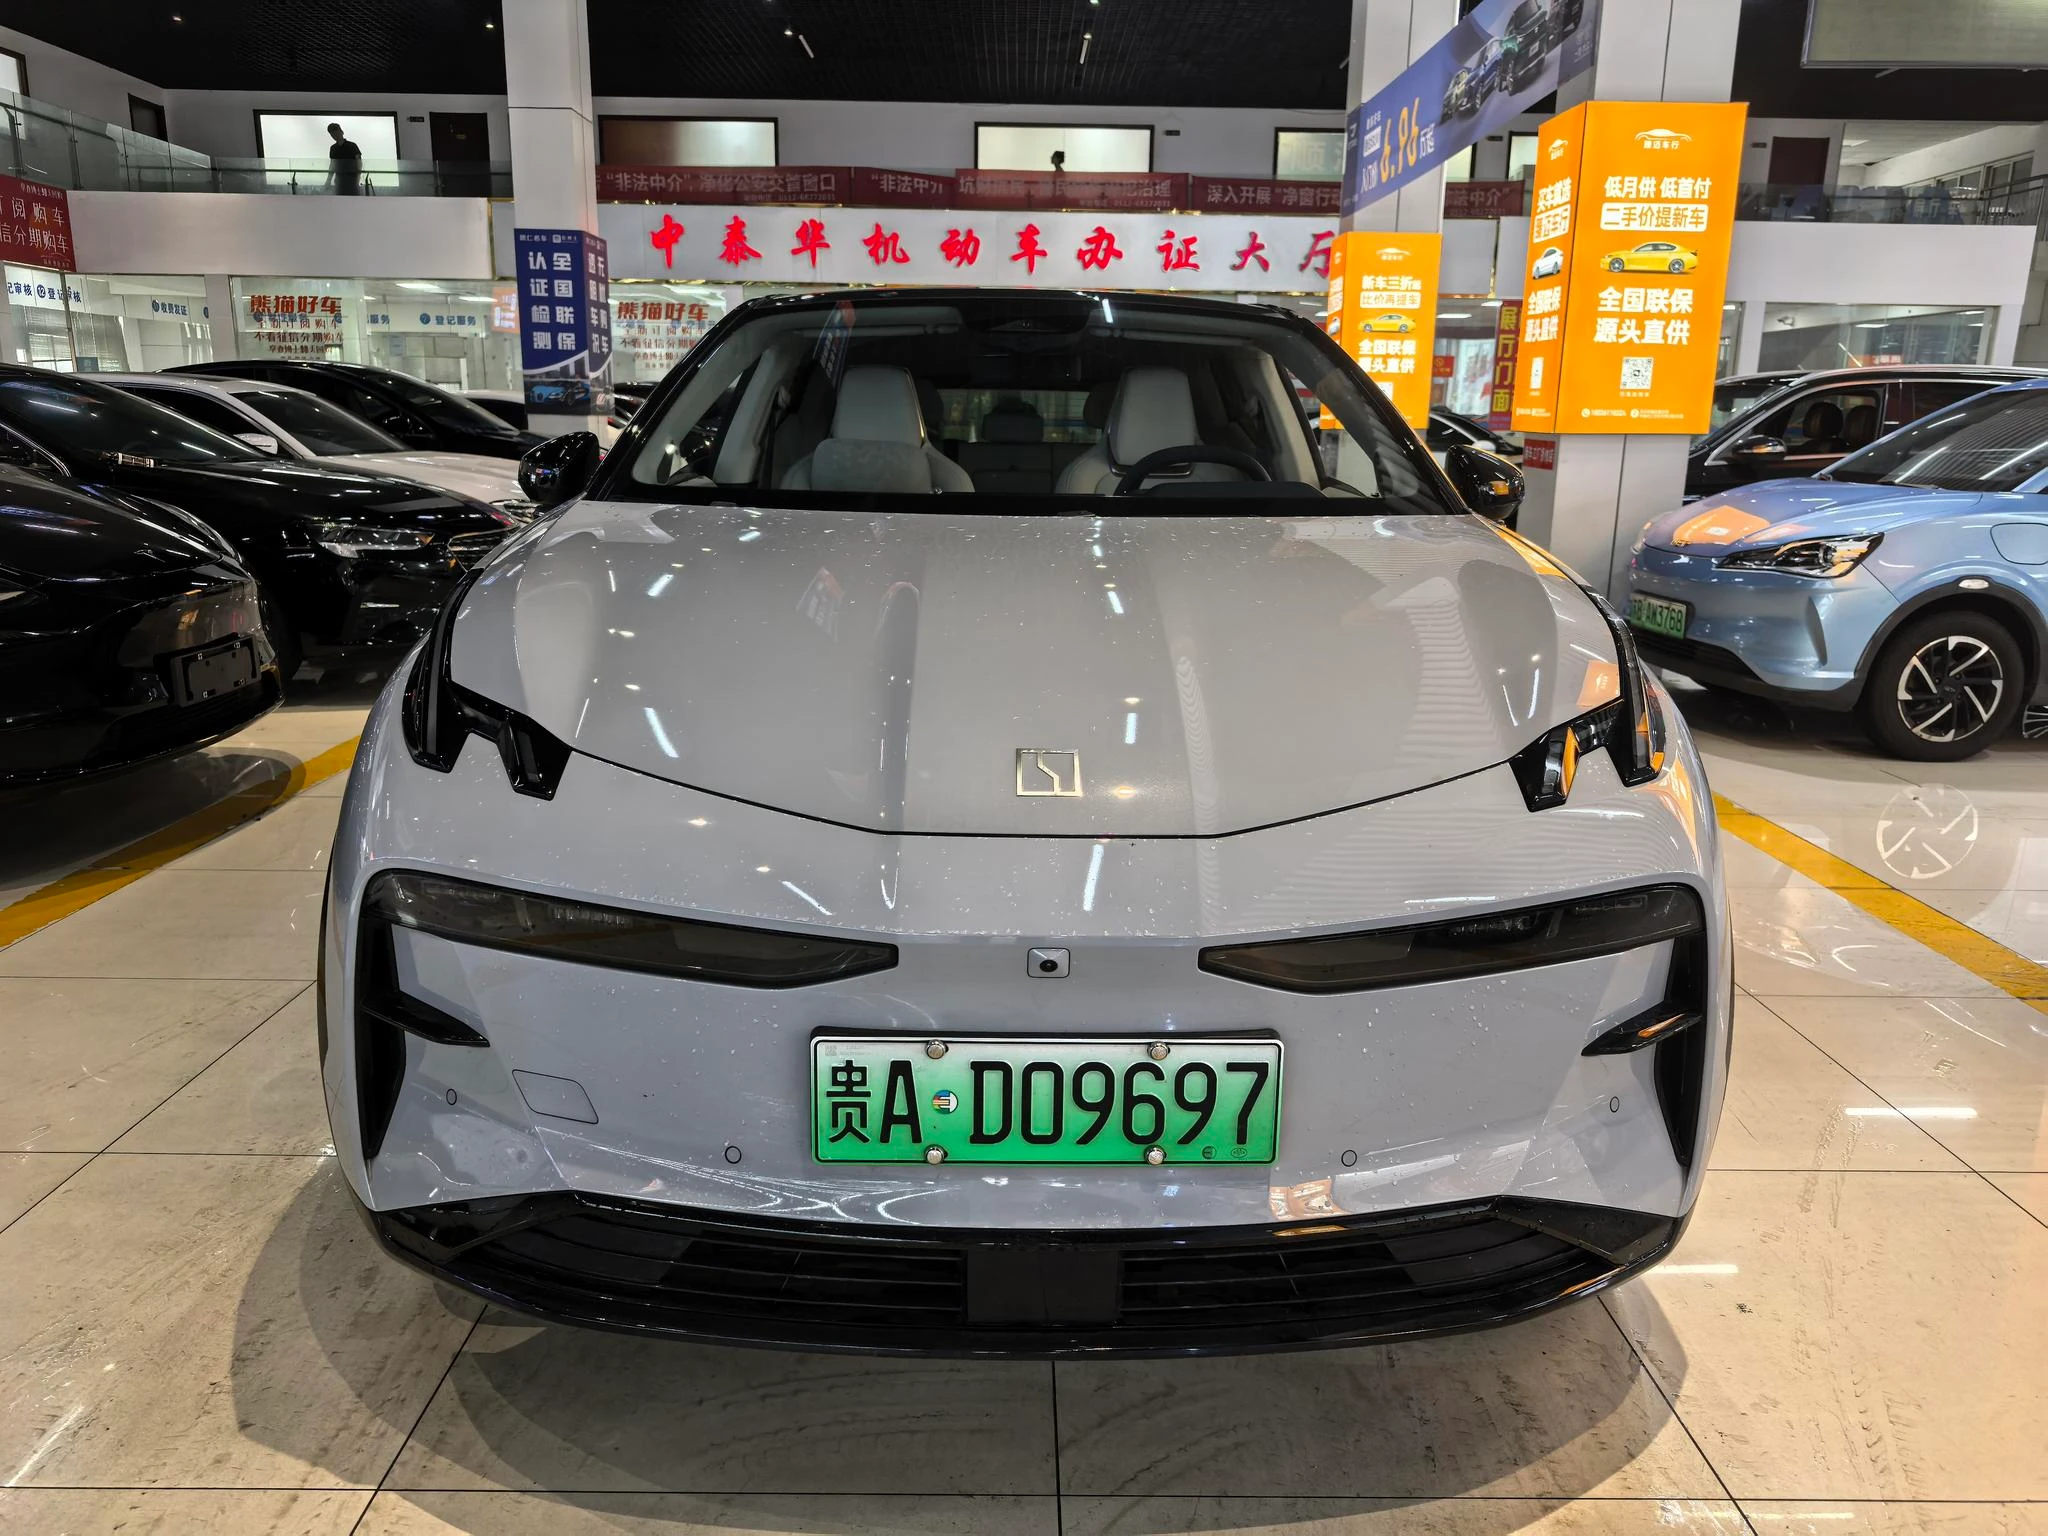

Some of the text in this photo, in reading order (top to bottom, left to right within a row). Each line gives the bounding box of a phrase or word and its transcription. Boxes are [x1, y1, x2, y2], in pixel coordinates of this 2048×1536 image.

[1604, 176, 1712, 199] 低月供 低首付
[1604, 206, 1705, 229] 二手价提新车
[250, 295, 342, 314] 熊猫好车
[618, 302, 710, 321] 熊猫好车
[1597, 286, 1693, 314] 全国联保
[1593, 318, 1690, 346] 源头直供
[970, 1061, 1270, 1145] D09697
